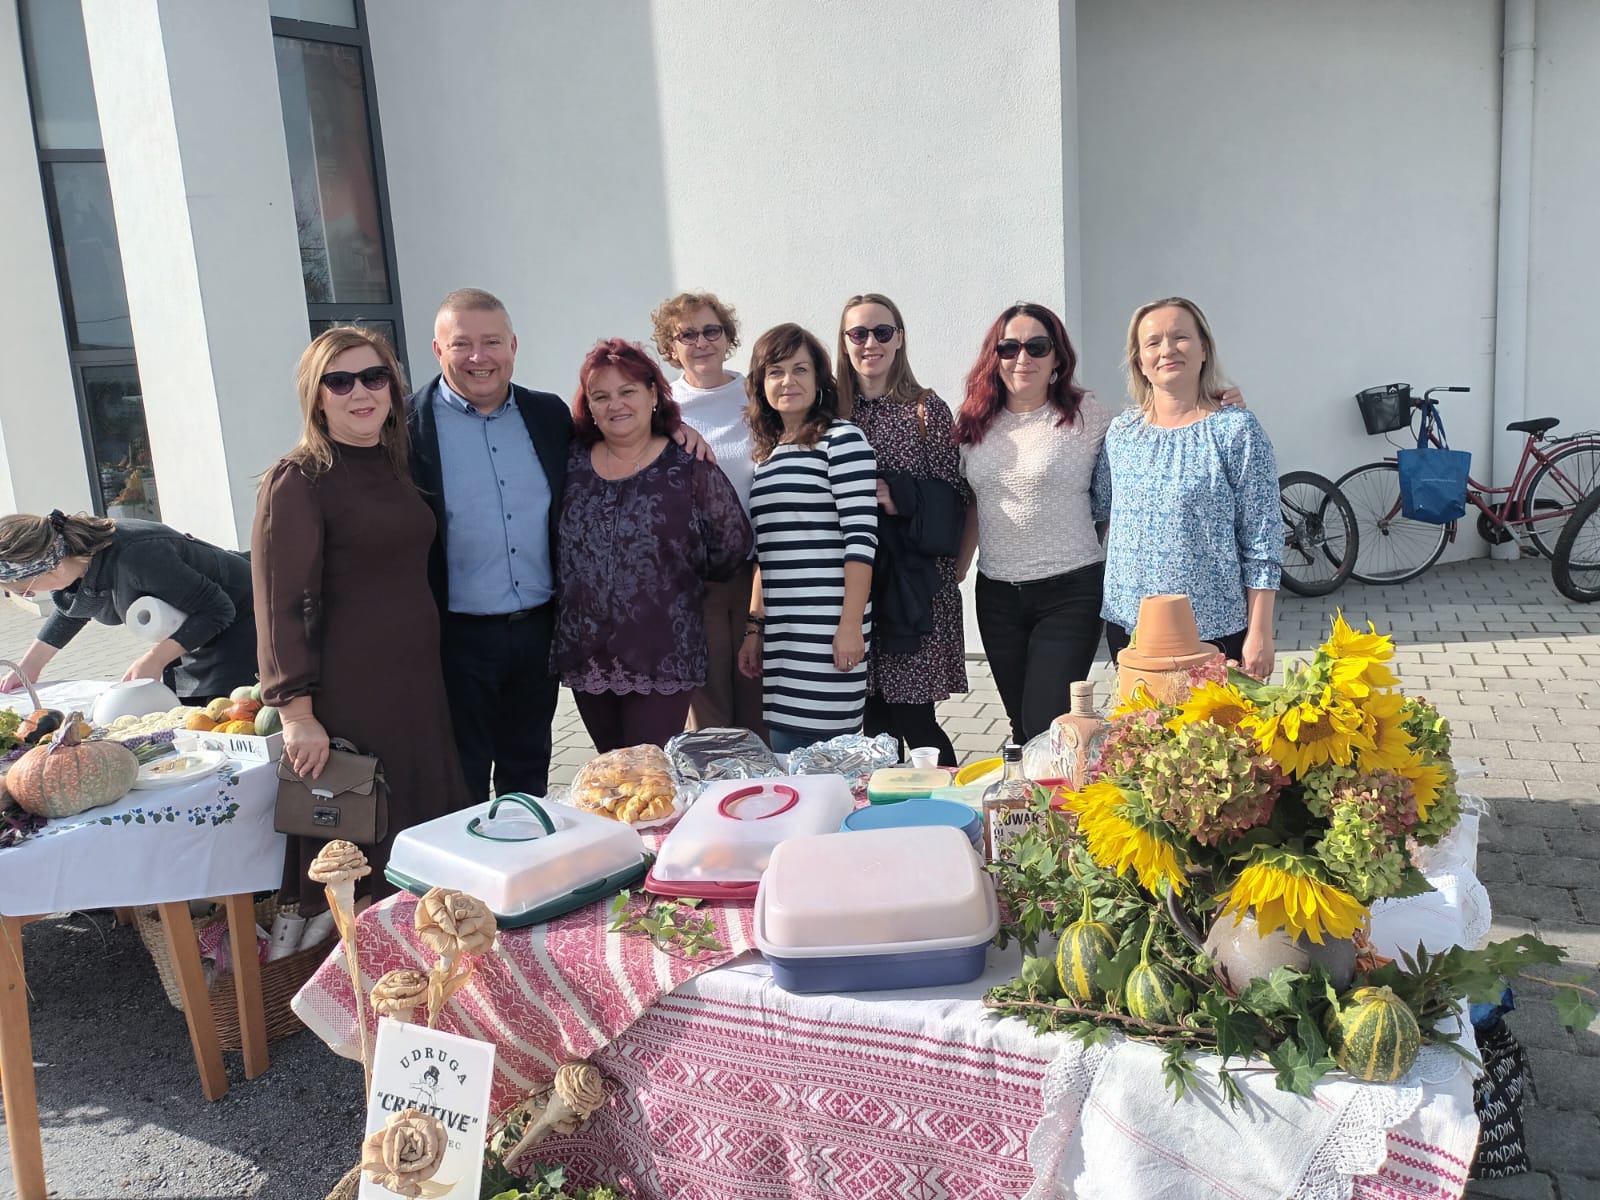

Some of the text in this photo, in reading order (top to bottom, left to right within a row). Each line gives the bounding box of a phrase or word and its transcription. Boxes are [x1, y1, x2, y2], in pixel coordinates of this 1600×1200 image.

[229, 738, 256, 754] LOVE
[399, 1046, 468, 1087] UDRUGA
[1493, 1052, 1516, 1083] LONDON
[1478, 1137, 1523, 1164] LONDON
